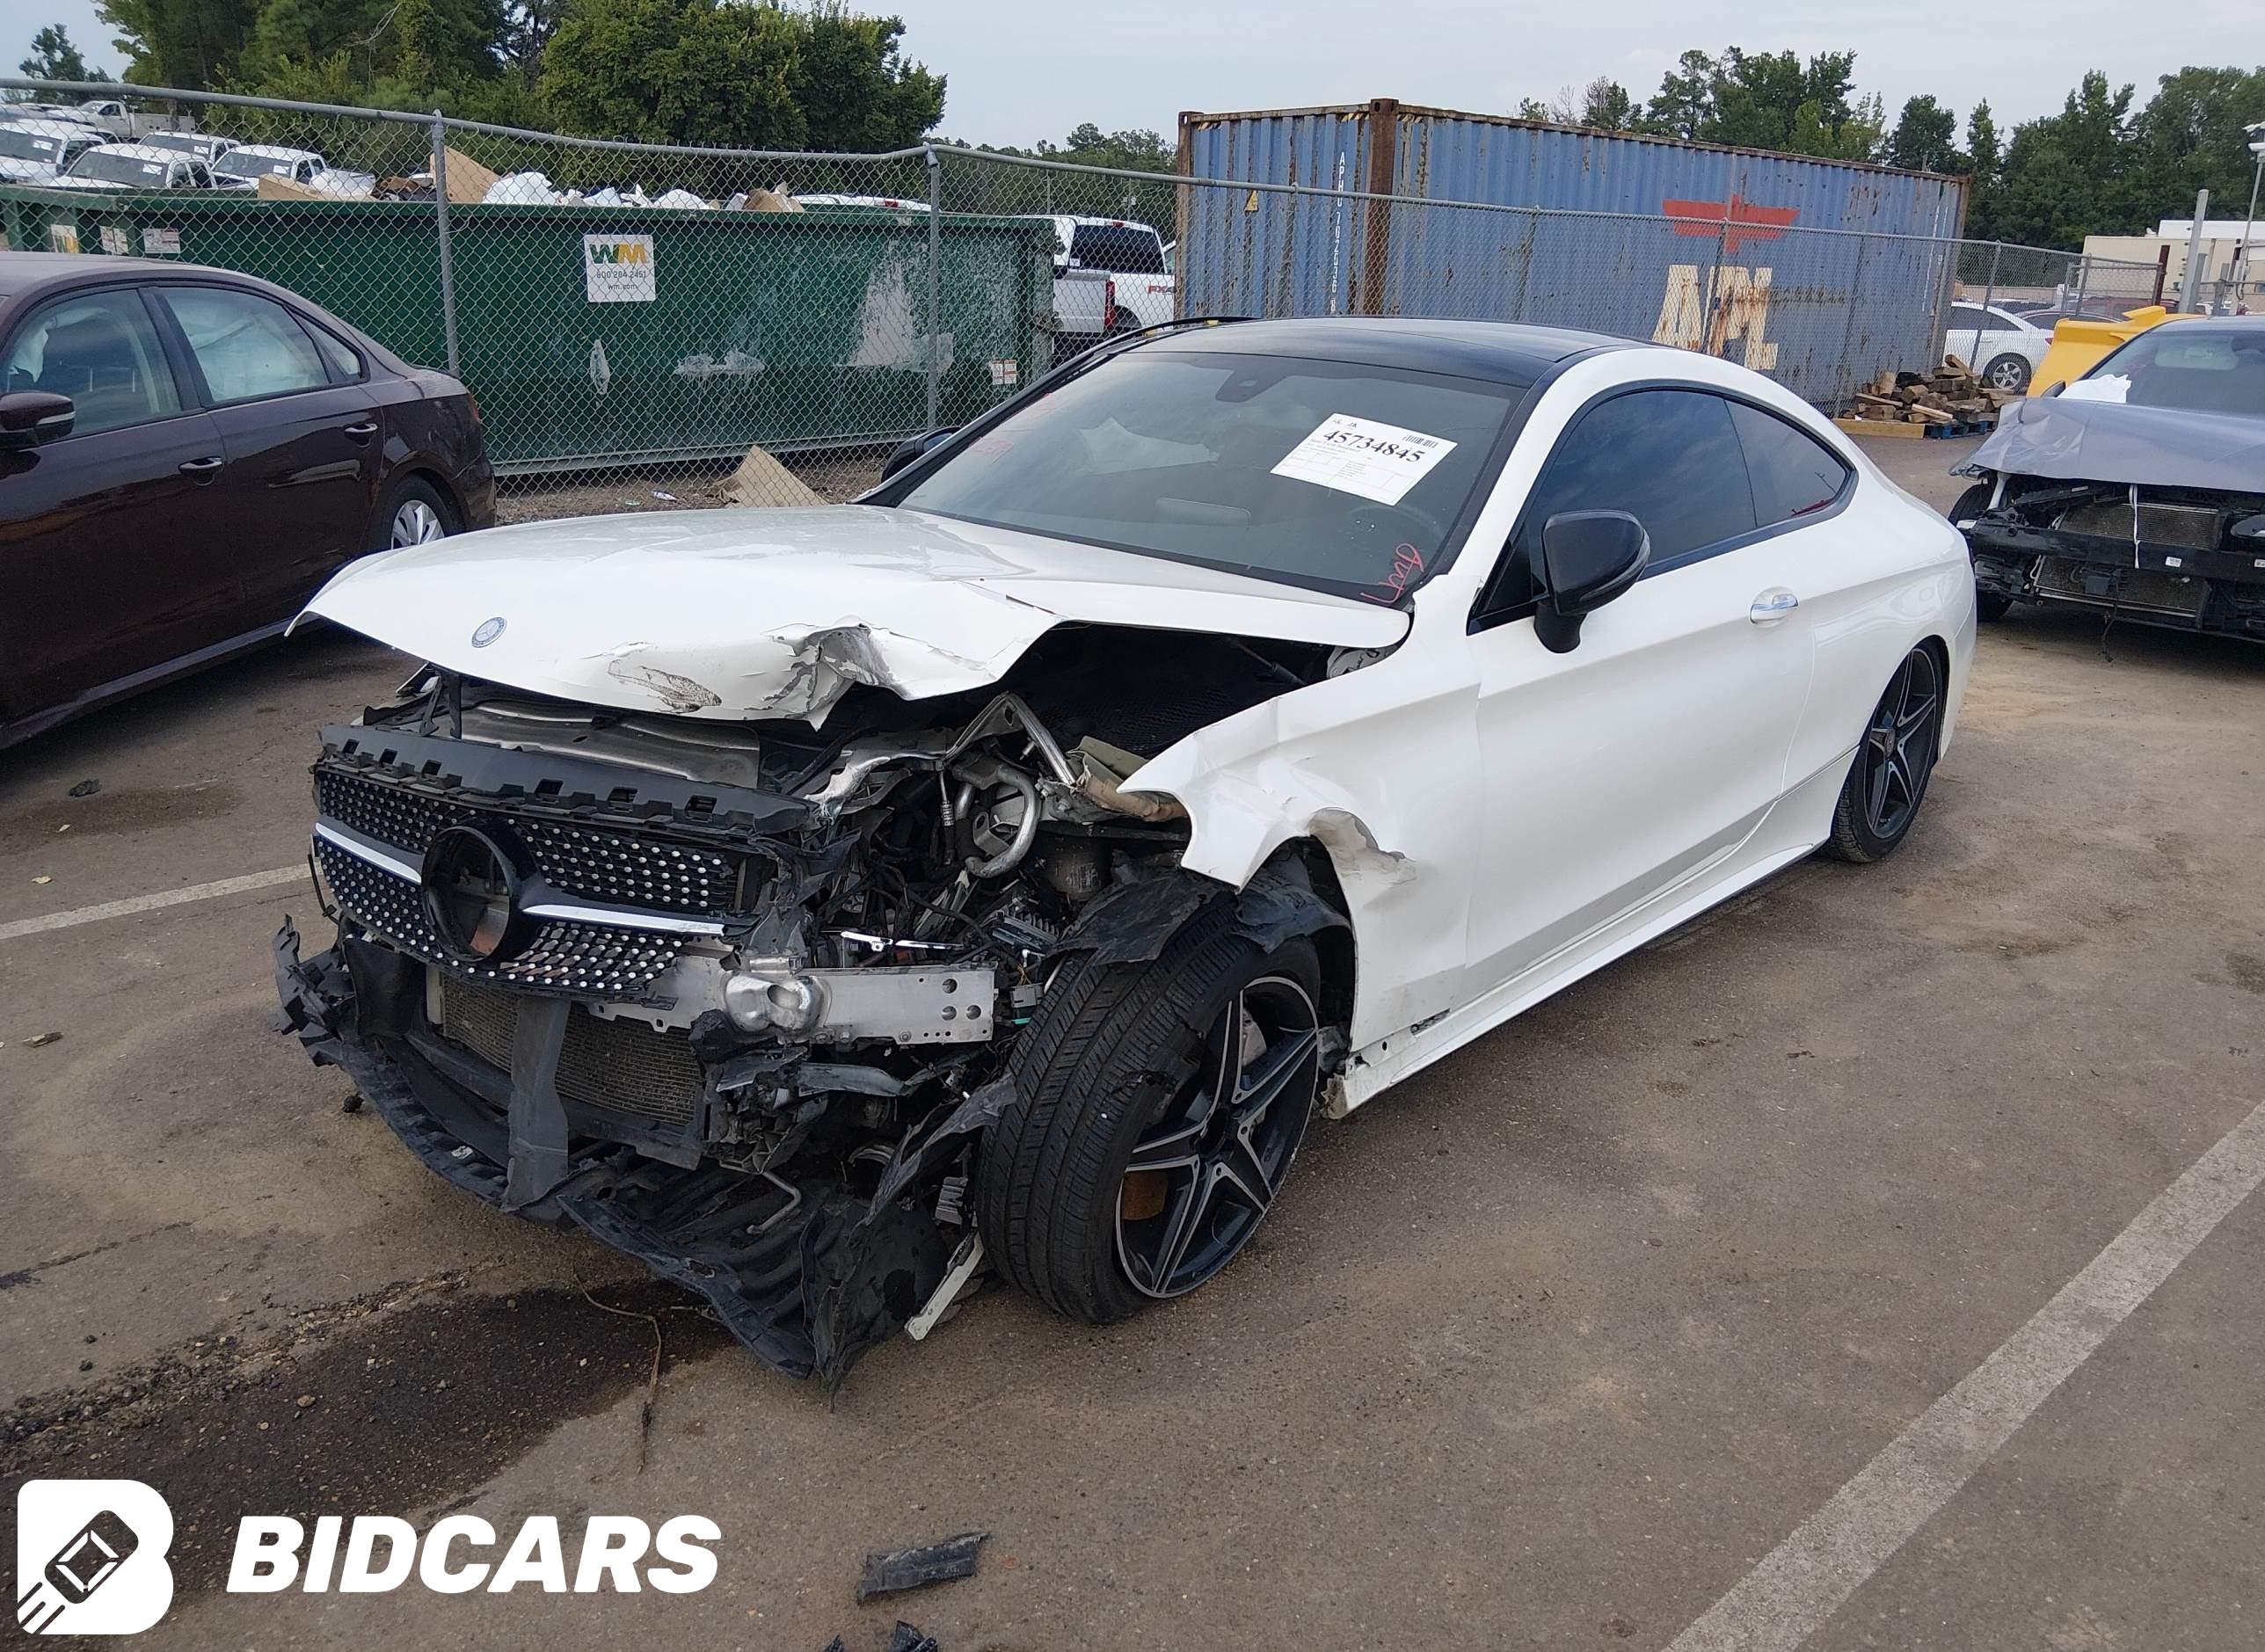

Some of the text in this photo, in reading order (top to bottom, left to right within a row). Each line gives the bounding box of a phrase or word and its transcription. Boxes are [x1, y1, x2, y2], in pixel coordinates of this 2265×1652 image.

[589, 244, 649, 264] WM
[1331, 211, 1341, 294] 702536
[1323, 430, 1425, 462] 45734845
